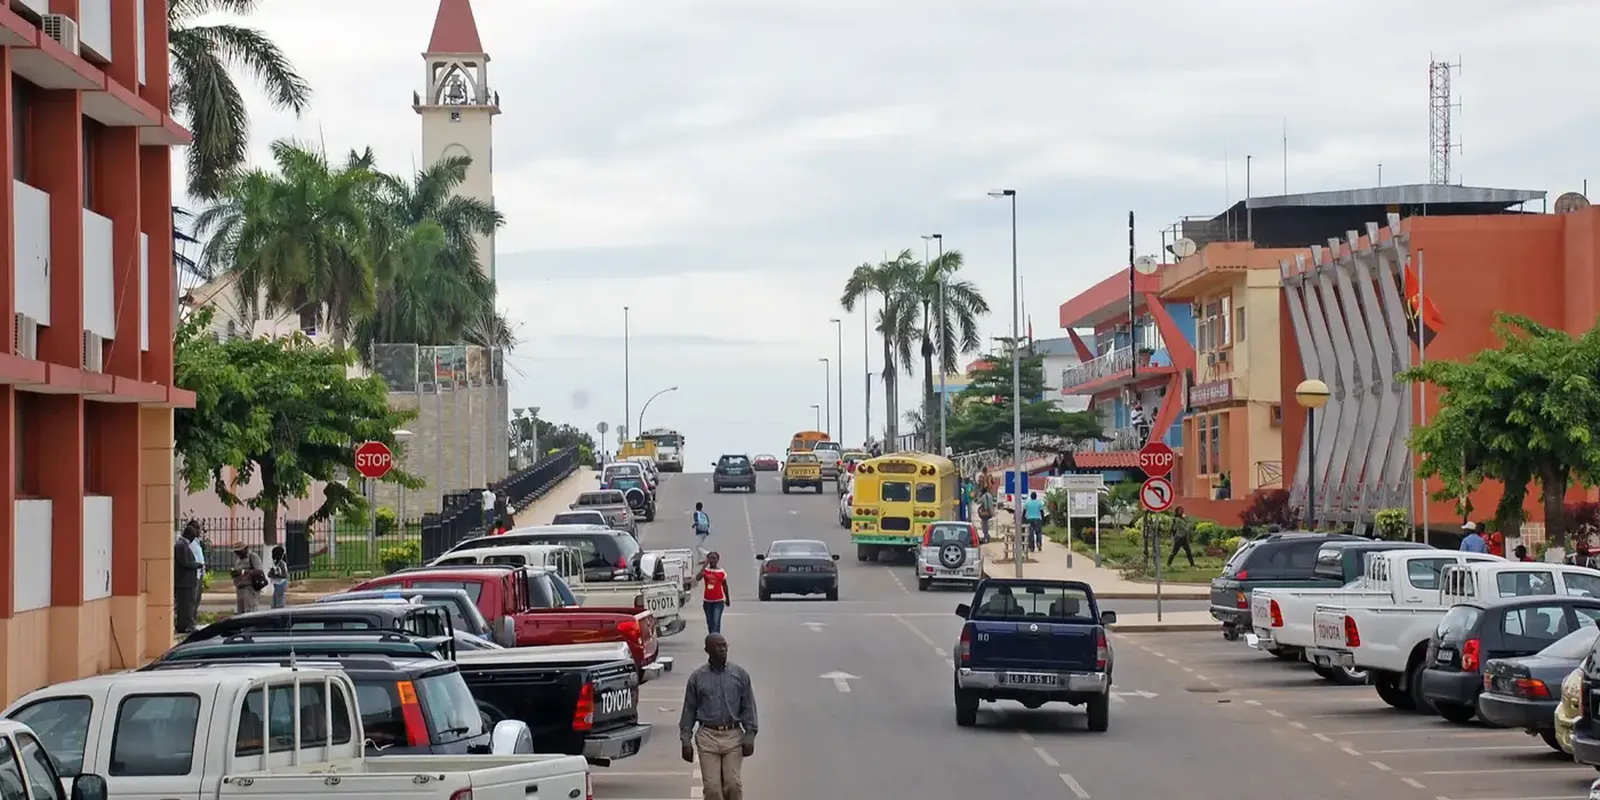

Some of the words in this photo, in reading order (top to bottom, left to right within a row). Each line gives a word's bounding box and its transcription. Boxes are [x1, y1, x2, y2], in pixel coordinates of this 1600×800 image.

[357, 453, 391, 467] STOP
[1140, 453, 1173, 467] STOP
[647, 596, 675, 611] TOYOTA
[1318, 624, 1341, 641] TOYOTA
[601, 688, 632, 714] TOYOTA
